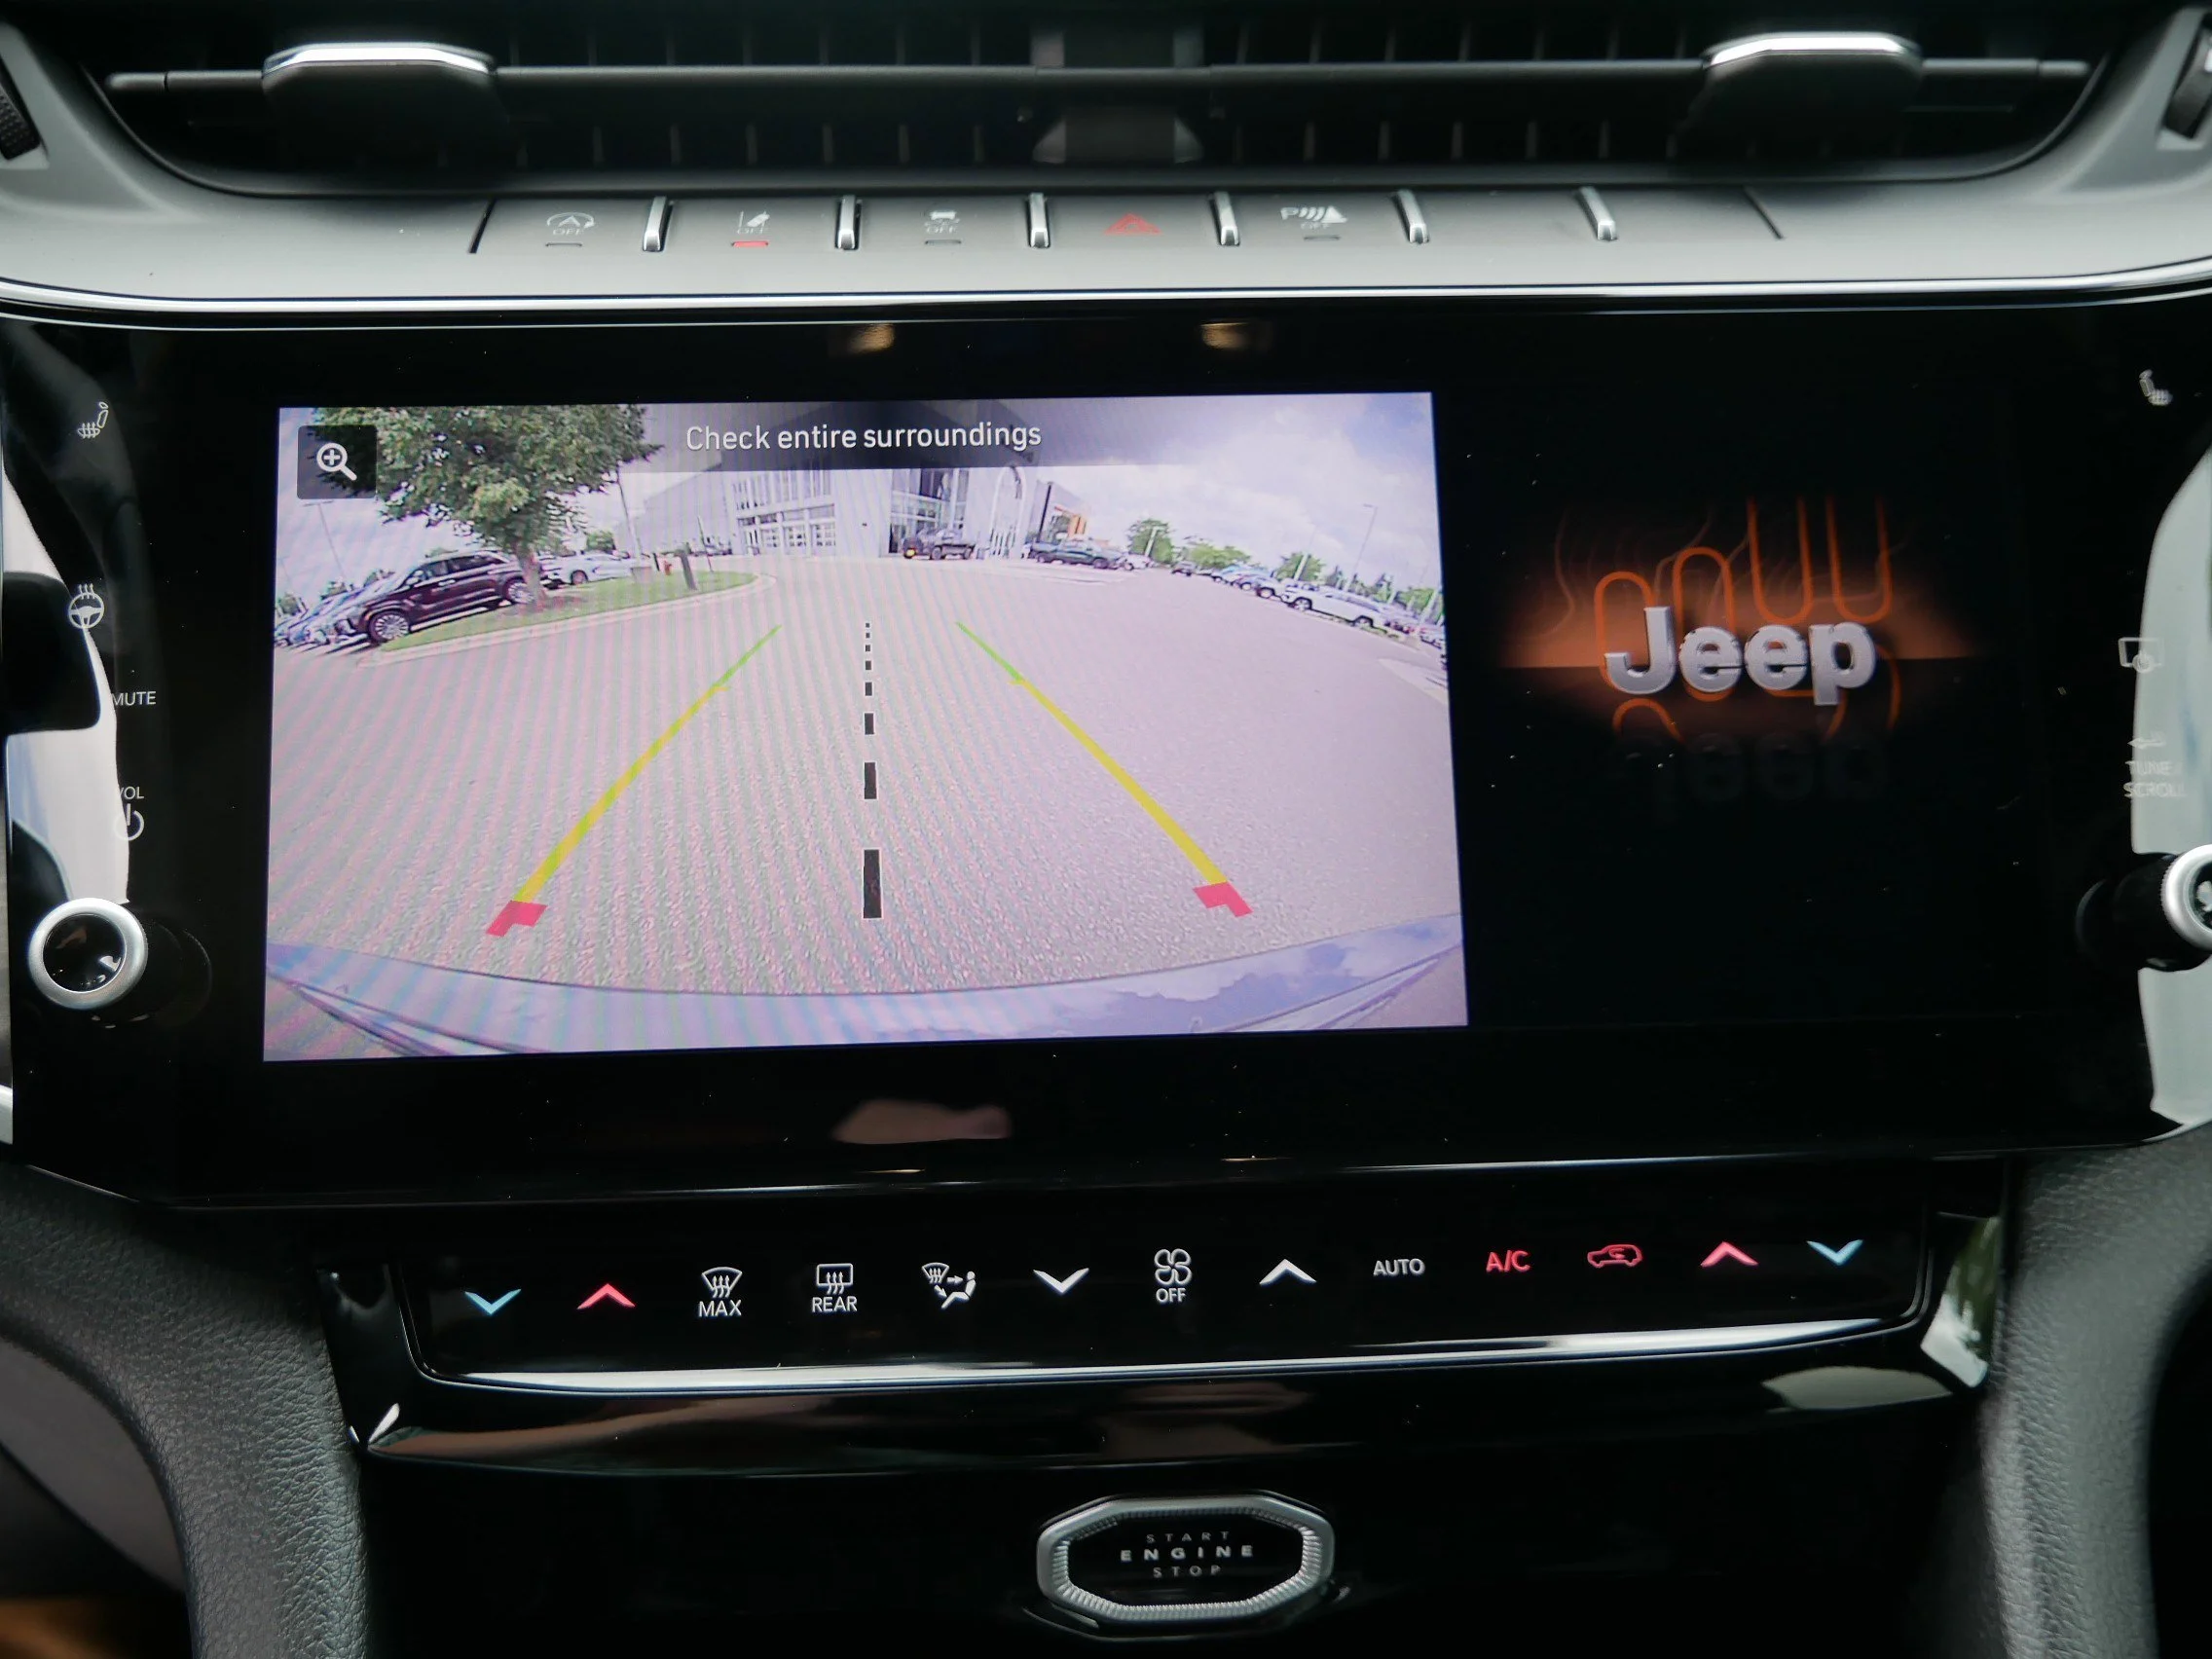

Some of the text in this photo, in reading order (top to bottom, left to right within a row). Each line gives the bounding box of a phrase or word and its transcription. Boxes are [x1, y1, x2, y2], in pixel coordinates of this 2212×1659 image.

[685, 422, 1042, 451] Check entire surroundings
[1604, 606, 1877, 707] Jeep
[112, 690, 157, 706] MUTE
[1373, 1258, 1425, 1276] AUTO
[1486, 1250, 1530, 1272] A/C
[812, 1296, 858, 1312] REAR
[1156, 1287, 1187, 1304] OFF
[699, 1300, 742, 1317] MAX
[1146, 1530, 1230, 1544] START
[1120, 1544, 1254, 1563] ENGINE
[1153, 1565, 1222, 1578] STOP
